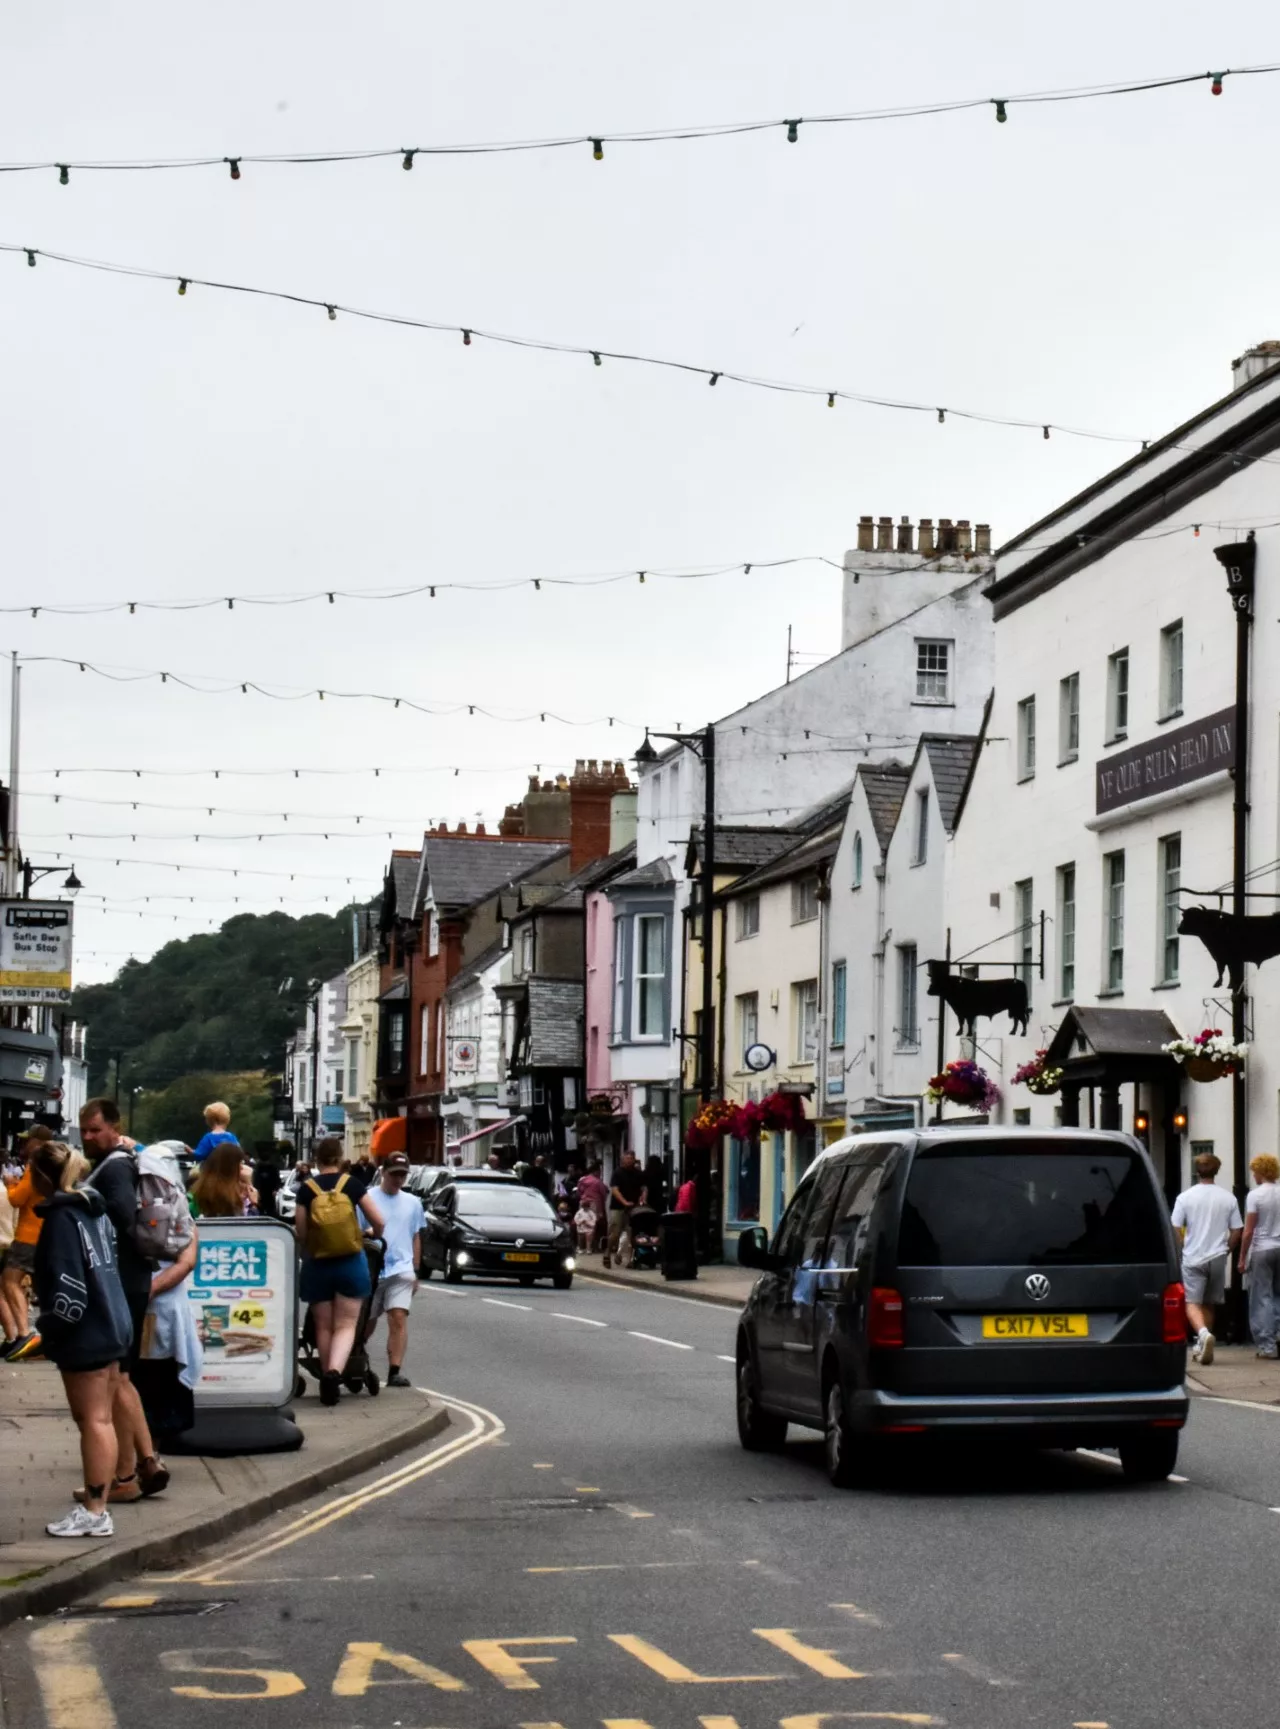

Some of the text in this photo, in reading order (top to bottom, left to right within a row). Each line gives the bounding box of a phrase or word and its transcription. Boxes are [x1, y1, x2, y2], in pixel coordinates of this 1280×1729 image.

[1101, 769, 1113, 799] YE
[1116, 759, 1141, 794] OLDE
[1180, 733, 1208, 770] HEAD
[1212, 722, 1231, 758] INN
[13, 932, 60, 942] Safle Bws
[14, 942, 58, 953] Bus Stop
[200, 1246, 261, 1263] MEAL
[199, 1263, 261, 1281] DEAL
[994, 1316, 1076, 1335] CX17 VSL
